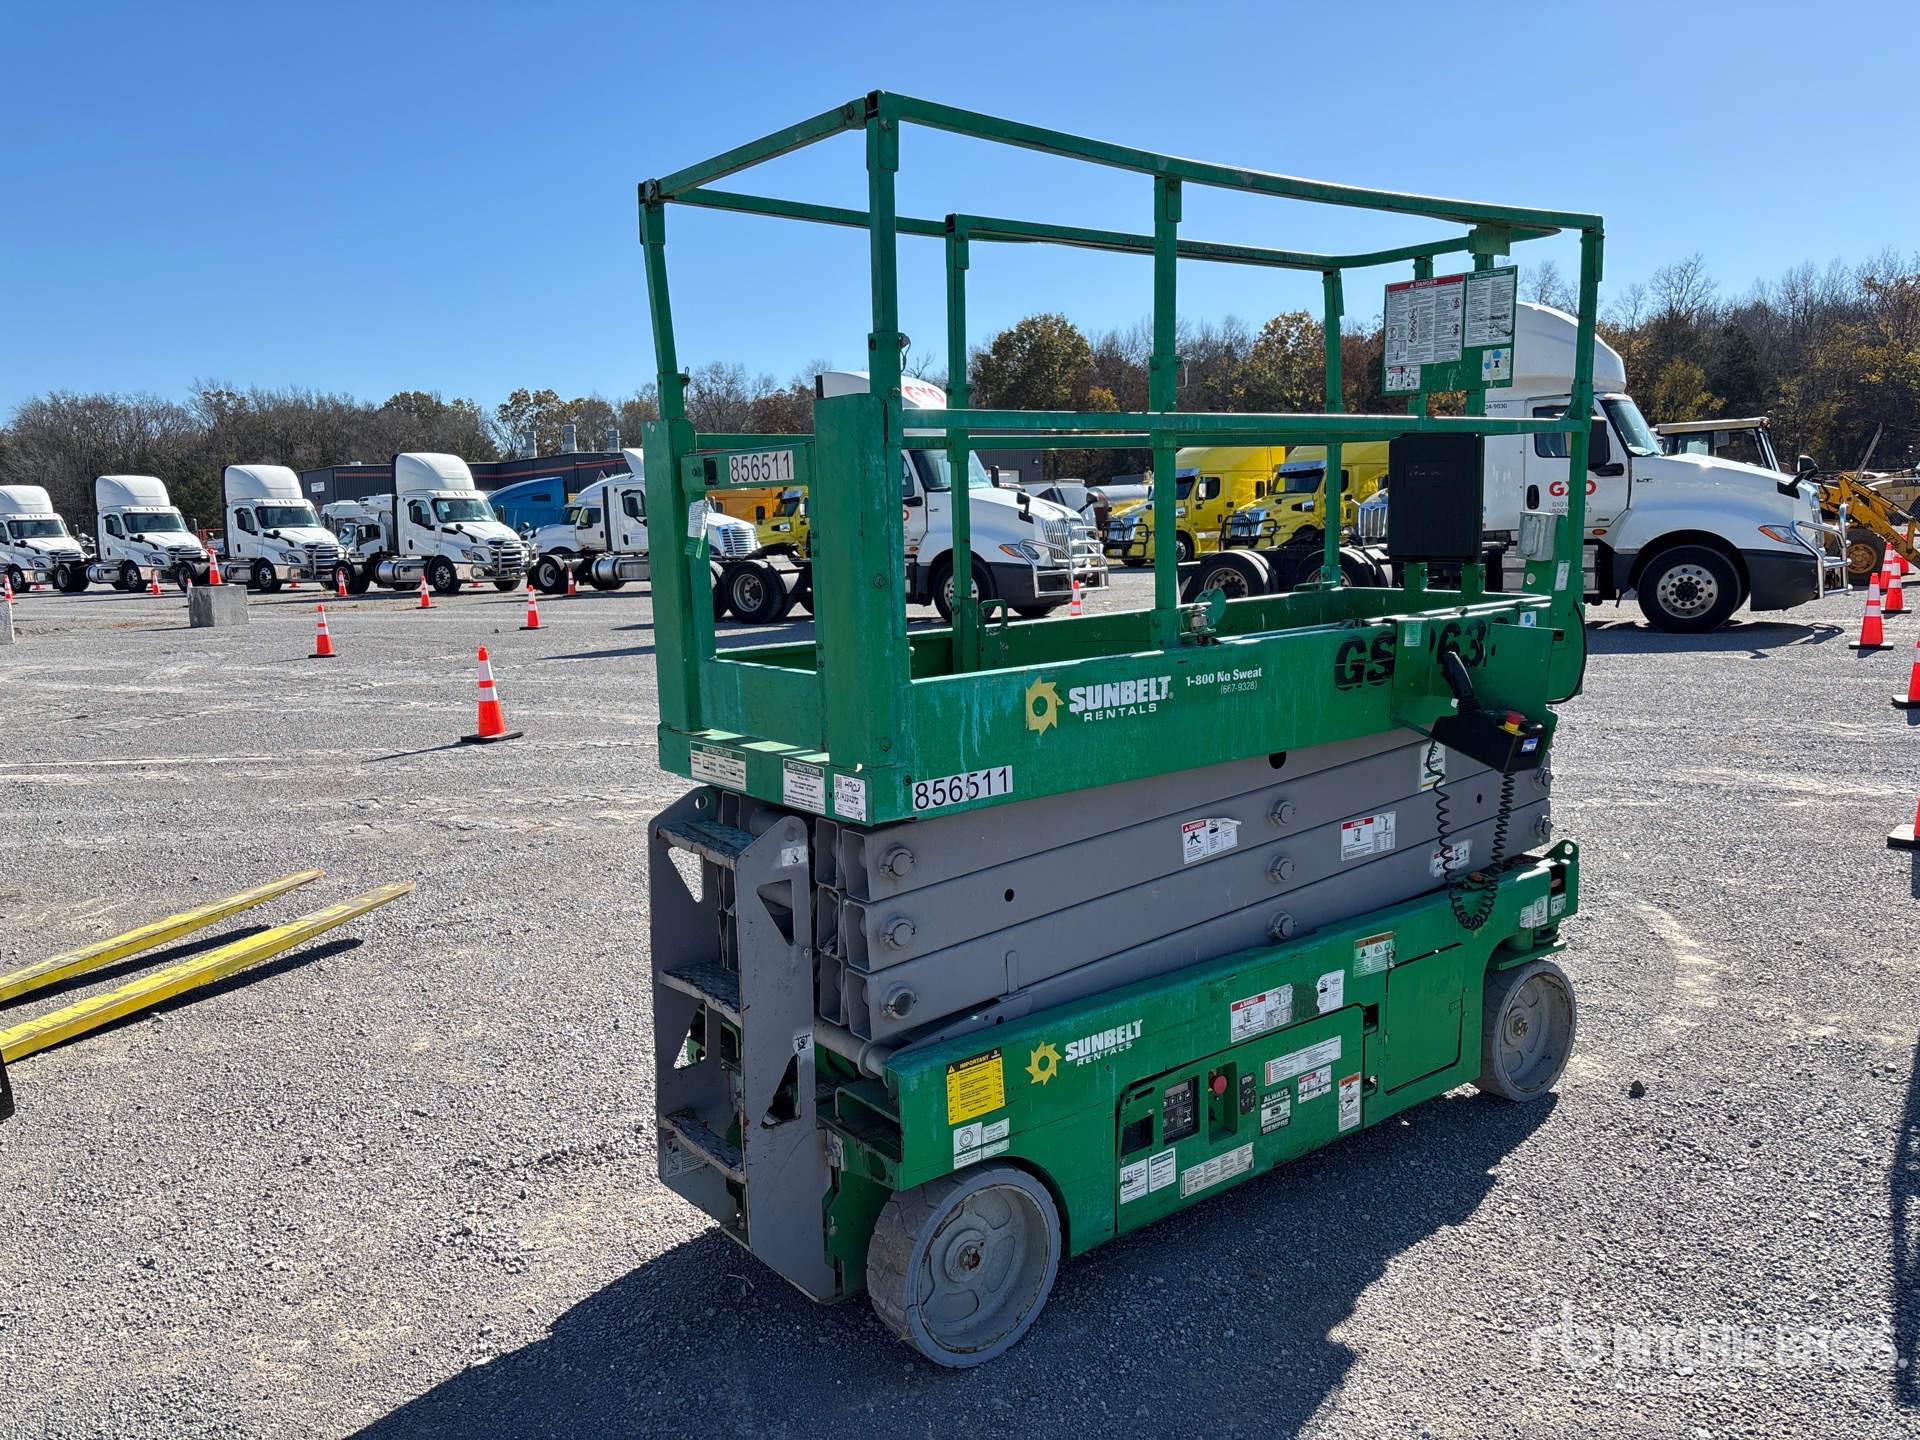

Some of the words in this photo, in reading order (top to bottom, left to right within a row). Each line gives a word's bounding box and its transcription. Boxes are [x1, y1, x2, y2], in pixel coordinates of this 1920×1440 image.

[1415, 279, 1438, 288] DANGER
[730, 451, 790, 483] 856511
[1186, 672, 1214, 687] 1-800
[1217, 670, 1231, 682] No
[1232, 666, 1262, 681] Sweat
[1068, 675, 1171, 715] SUNBELT
[1220, 680, 1258, 694] (667-9328)
[1083, 703, 1157, 722] RENTALS
[702, 745, 733, 759] INSTRUCTIONS
[787, 761, 820, 775] INSTRUCTIONS
[914, 766, 1008, 809] 856511
[1243, 997, 1259, 1007] DANGER
[1065, 1018, 1143, 1062] SUNBELT
[959, 1054, 989, 1070] IMPORTANT
[1076, 1041, 1133, 1067] RENTALS
[1263, 1088, 1289, 1103] ALWAYS
[1262, 1118, 1289, 1134] SIEMPRE
